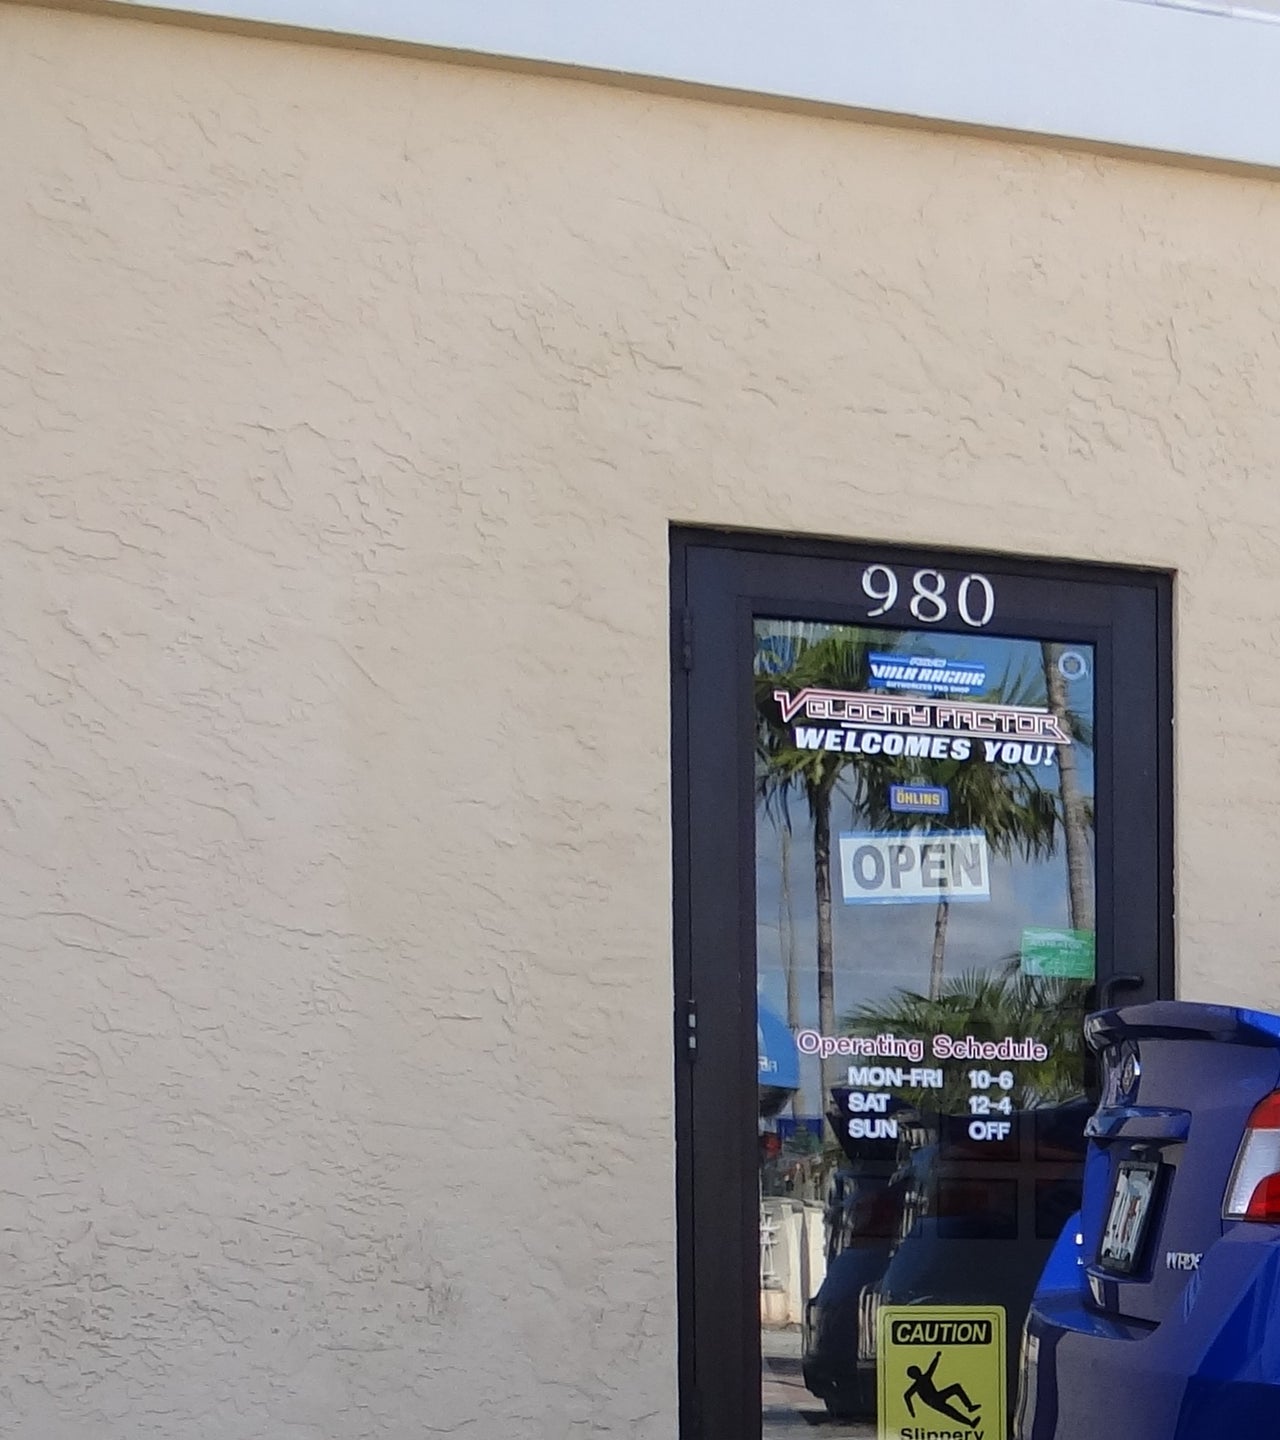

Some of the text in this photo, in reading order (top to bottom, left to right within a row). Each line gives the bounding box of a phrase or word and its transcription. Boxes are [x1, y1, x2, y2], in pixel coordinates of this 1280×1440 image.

[861, 563, 995, 628] 980
[936, 704, 1072, 745] FACTOR
[794, 727, 1055, 766] WELCOMES YOU!
[852, 843, 983, 891] OPEN
[797, 1030, 1048, 1062] Operating Schedule
[848, 1066, 1014, 1090] MON-FRI 10-6
[848, 1093, 1012, 1115] SAT 12-4
[848, 1119, 1012, 1141] SUN OFF
[896, 1322, 987, 1343] CAUTION
